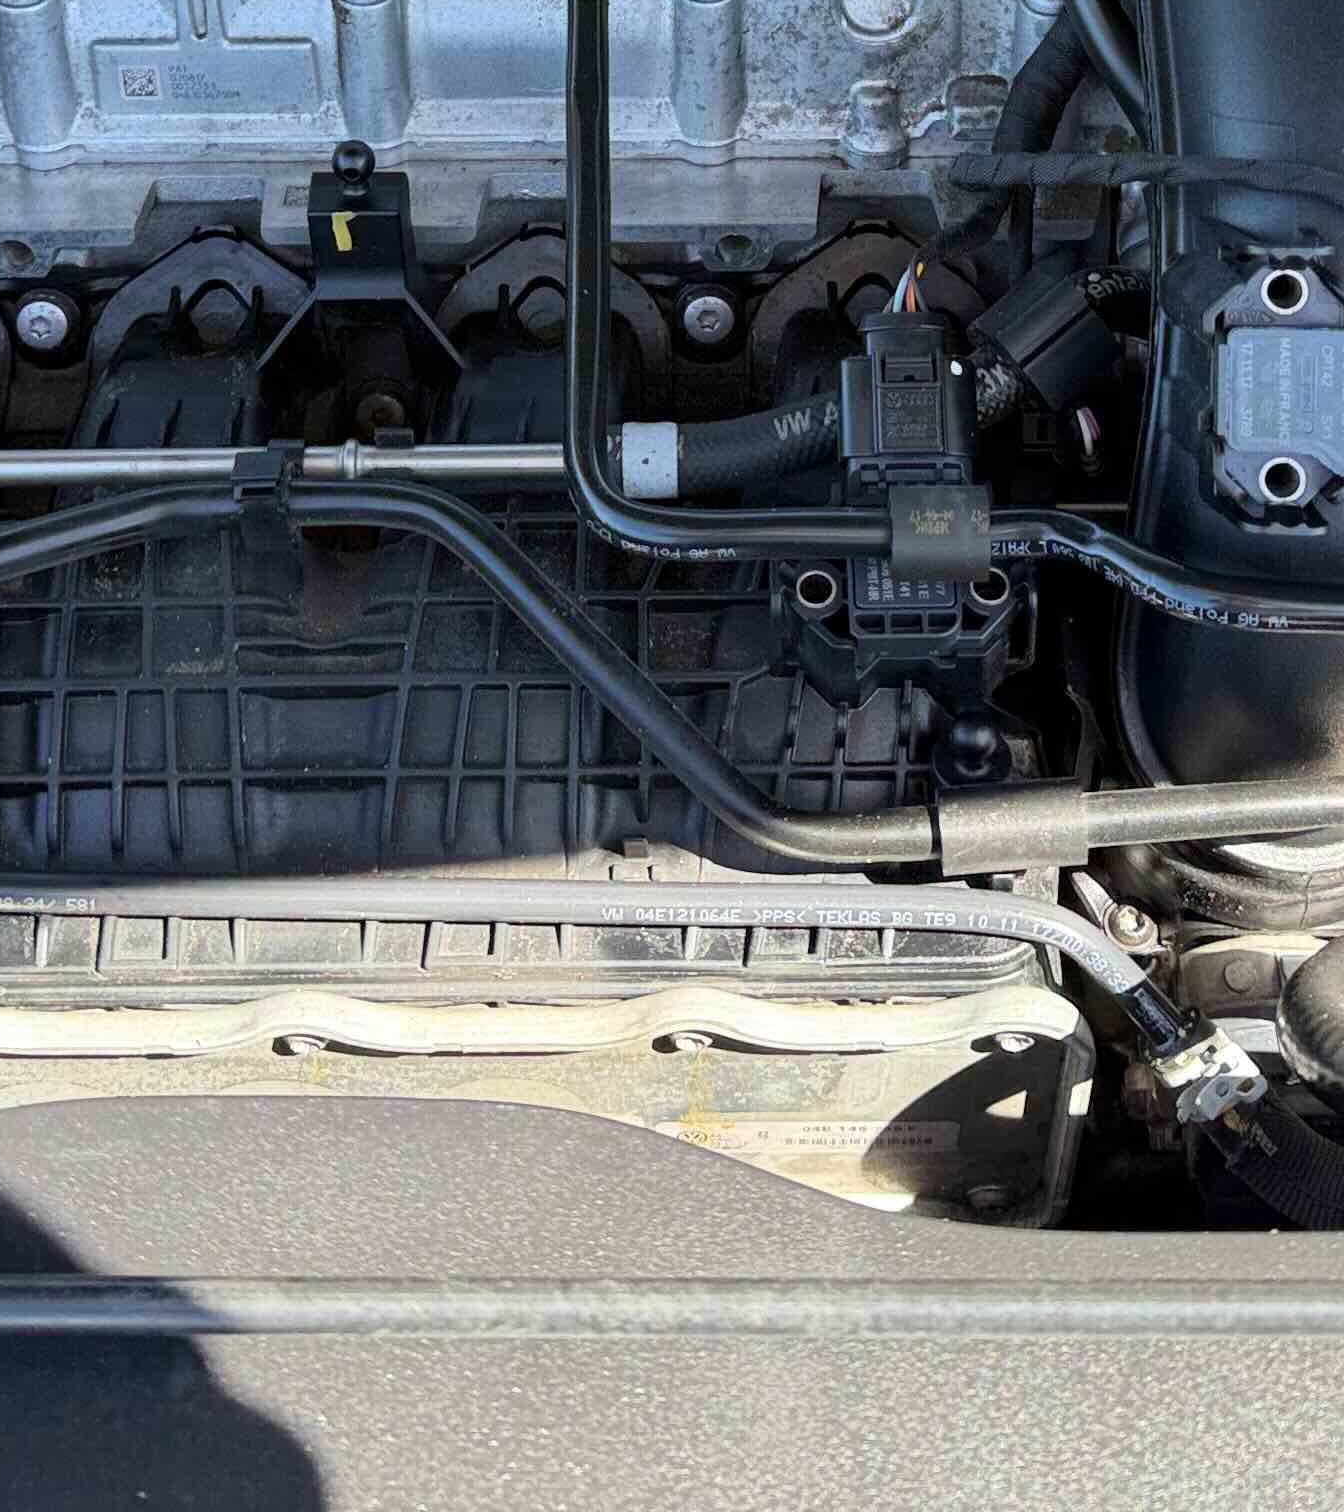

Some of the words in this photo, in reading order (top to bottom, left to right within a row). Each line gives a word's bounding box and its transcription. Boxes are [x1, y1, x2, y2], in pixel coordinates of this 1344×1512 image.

[772, 406, 812, 441] VW
[64, 896, 98, 914] 581
[601, 907, 625, 921] VW
[816, 909, 881, 926] TEKLAS
